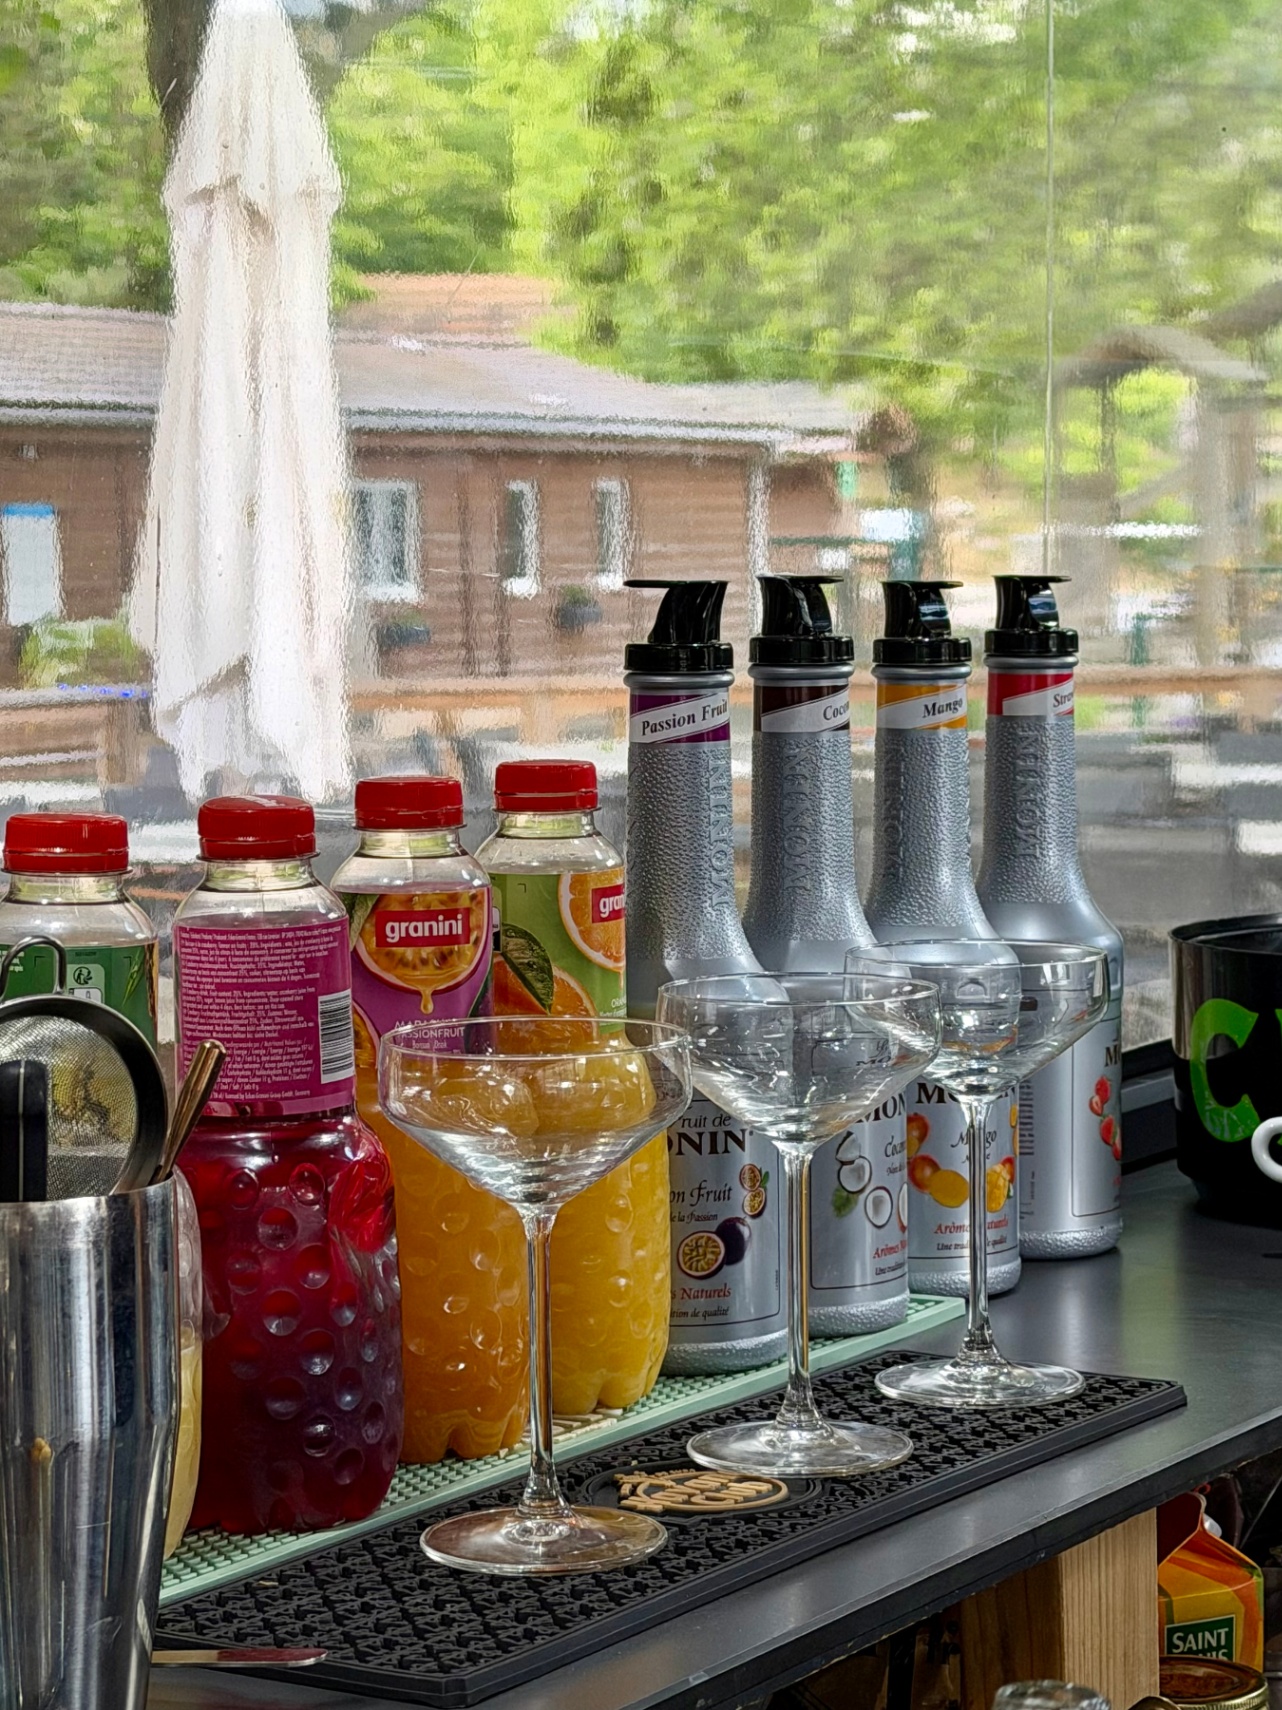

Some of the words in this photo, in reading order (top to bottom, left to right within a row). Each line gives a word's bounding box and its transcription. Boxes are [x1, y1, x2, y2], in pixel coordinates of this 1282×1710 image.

[922, 697, 963, 719] Mango
[641, 709, 696, 737] Passion
[385, 913, 463, 943] granini
[712, 1113, 731, 1127] de
[690, 1179, 733, 1207] Fruit
[680, 1282, 732, 1300] Naturels
[690, 1307, 700, 1318] de
[1172, 1627, 1229, 1654] SAINT
